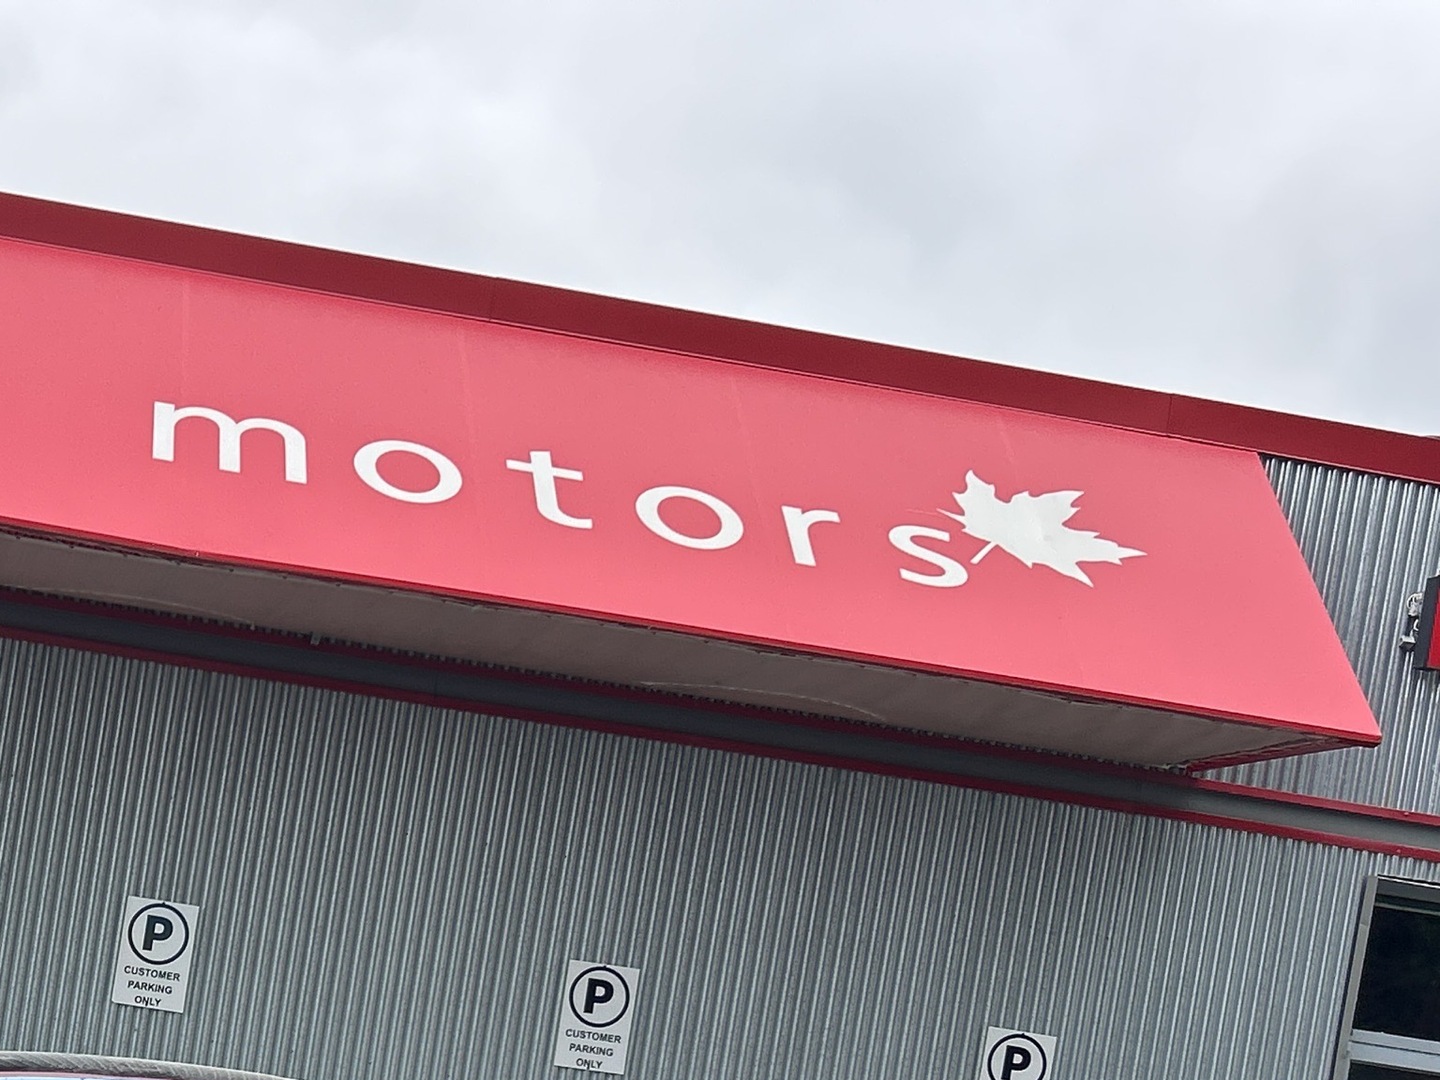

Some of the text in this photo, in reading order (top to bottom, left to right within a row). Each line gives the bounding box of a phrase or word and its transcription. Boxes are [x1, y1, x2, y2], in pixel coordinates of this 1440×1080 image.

[152, 401, 969, 588] motors
[141, 914, 173, 951] P
[123, 965, 181, 982] CUSTOMER
[127, 980, 173, 995] PARKING
[583, 977, 614, 1014] P
[134, 995, 162, 1007] ONLY
[565, 1028, 622, 1044] CUSTOMER
[569, 1043, 614, 1057] PARKING
[575, 1058, 603, 1069] ONLY
[1001, 1045, 1032, 1080] P
